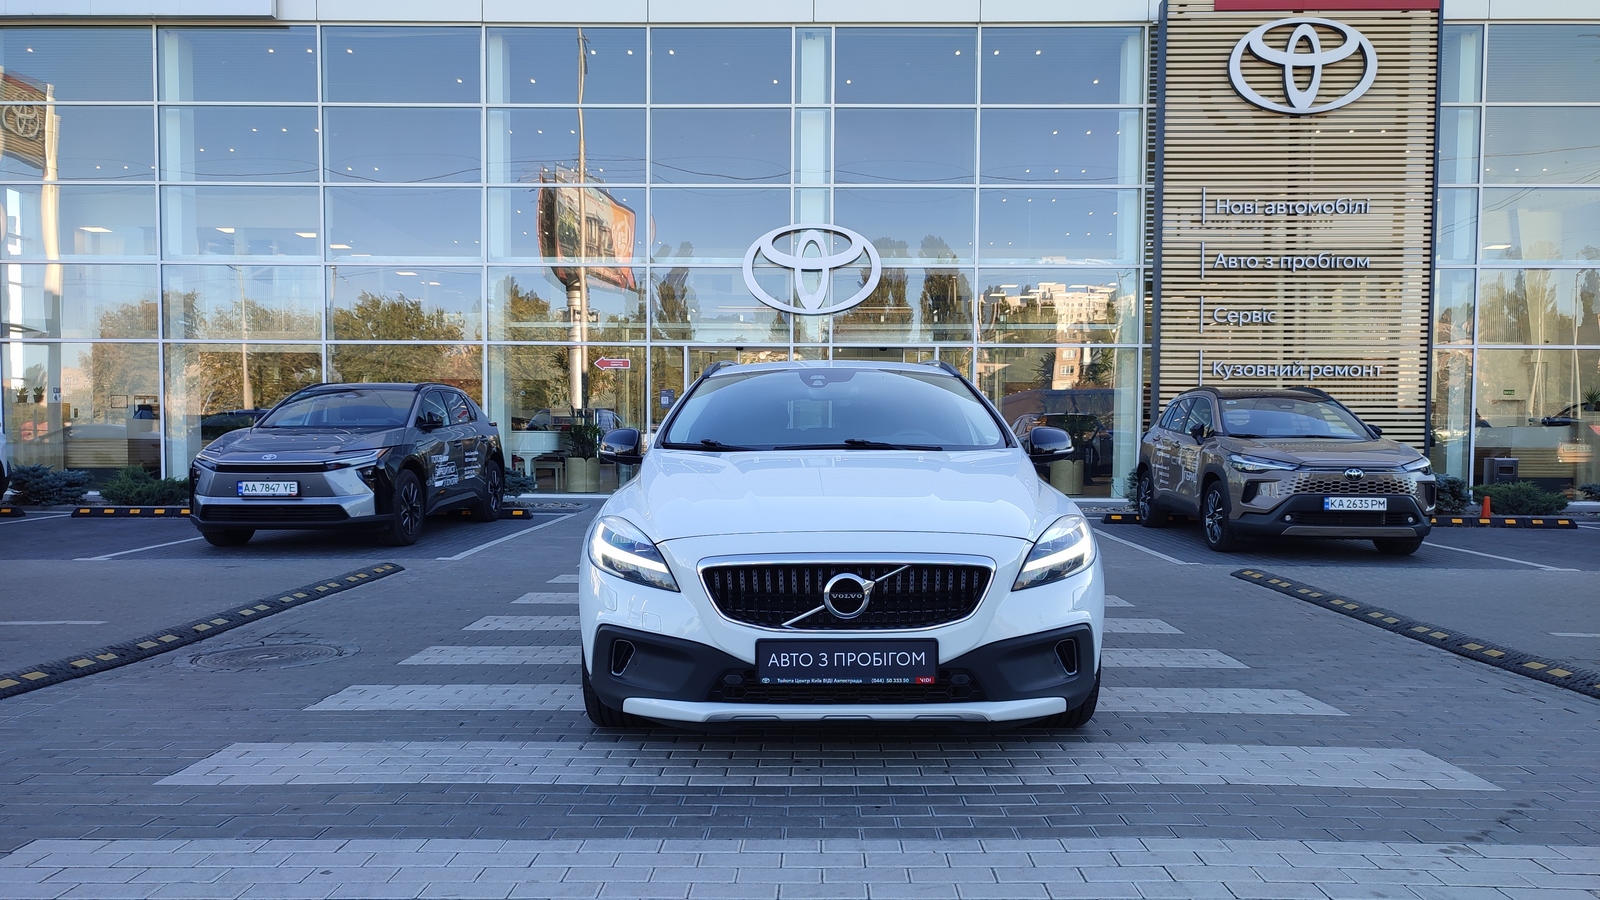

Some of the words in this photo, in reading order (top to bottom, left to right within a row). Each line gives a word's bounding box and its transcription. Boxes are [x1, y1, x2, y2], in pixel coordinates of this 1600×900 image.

[1216, 198, 1259, 214] Нові
[1264, 198, 1371, 214] автомобілі
[1213, 253, 1259, 269] Авто
[1263, 256, 1274, 269] з
[1280, 252, 1371, 273] пробігом
[1213, 307, 1277, 326] Сервіс
[1212, 360, 1304, 380] Кузовний
[1309, 364, 1383, 380] ремонт
[243, 483, 258, 493] AA
[259, 483, 281, 493] 7847
[283, 483, 296, 493] YE
[1330, 499, 1345, 509] KA
[1346, 499, 1370, 509] 2635
[1370, 499, 1386, 509] PM
[767, 652, 813, 667] АВТО
[818, 652, 829, 667] З
[834, 651, 926, 667] ПРОБІГОМ
